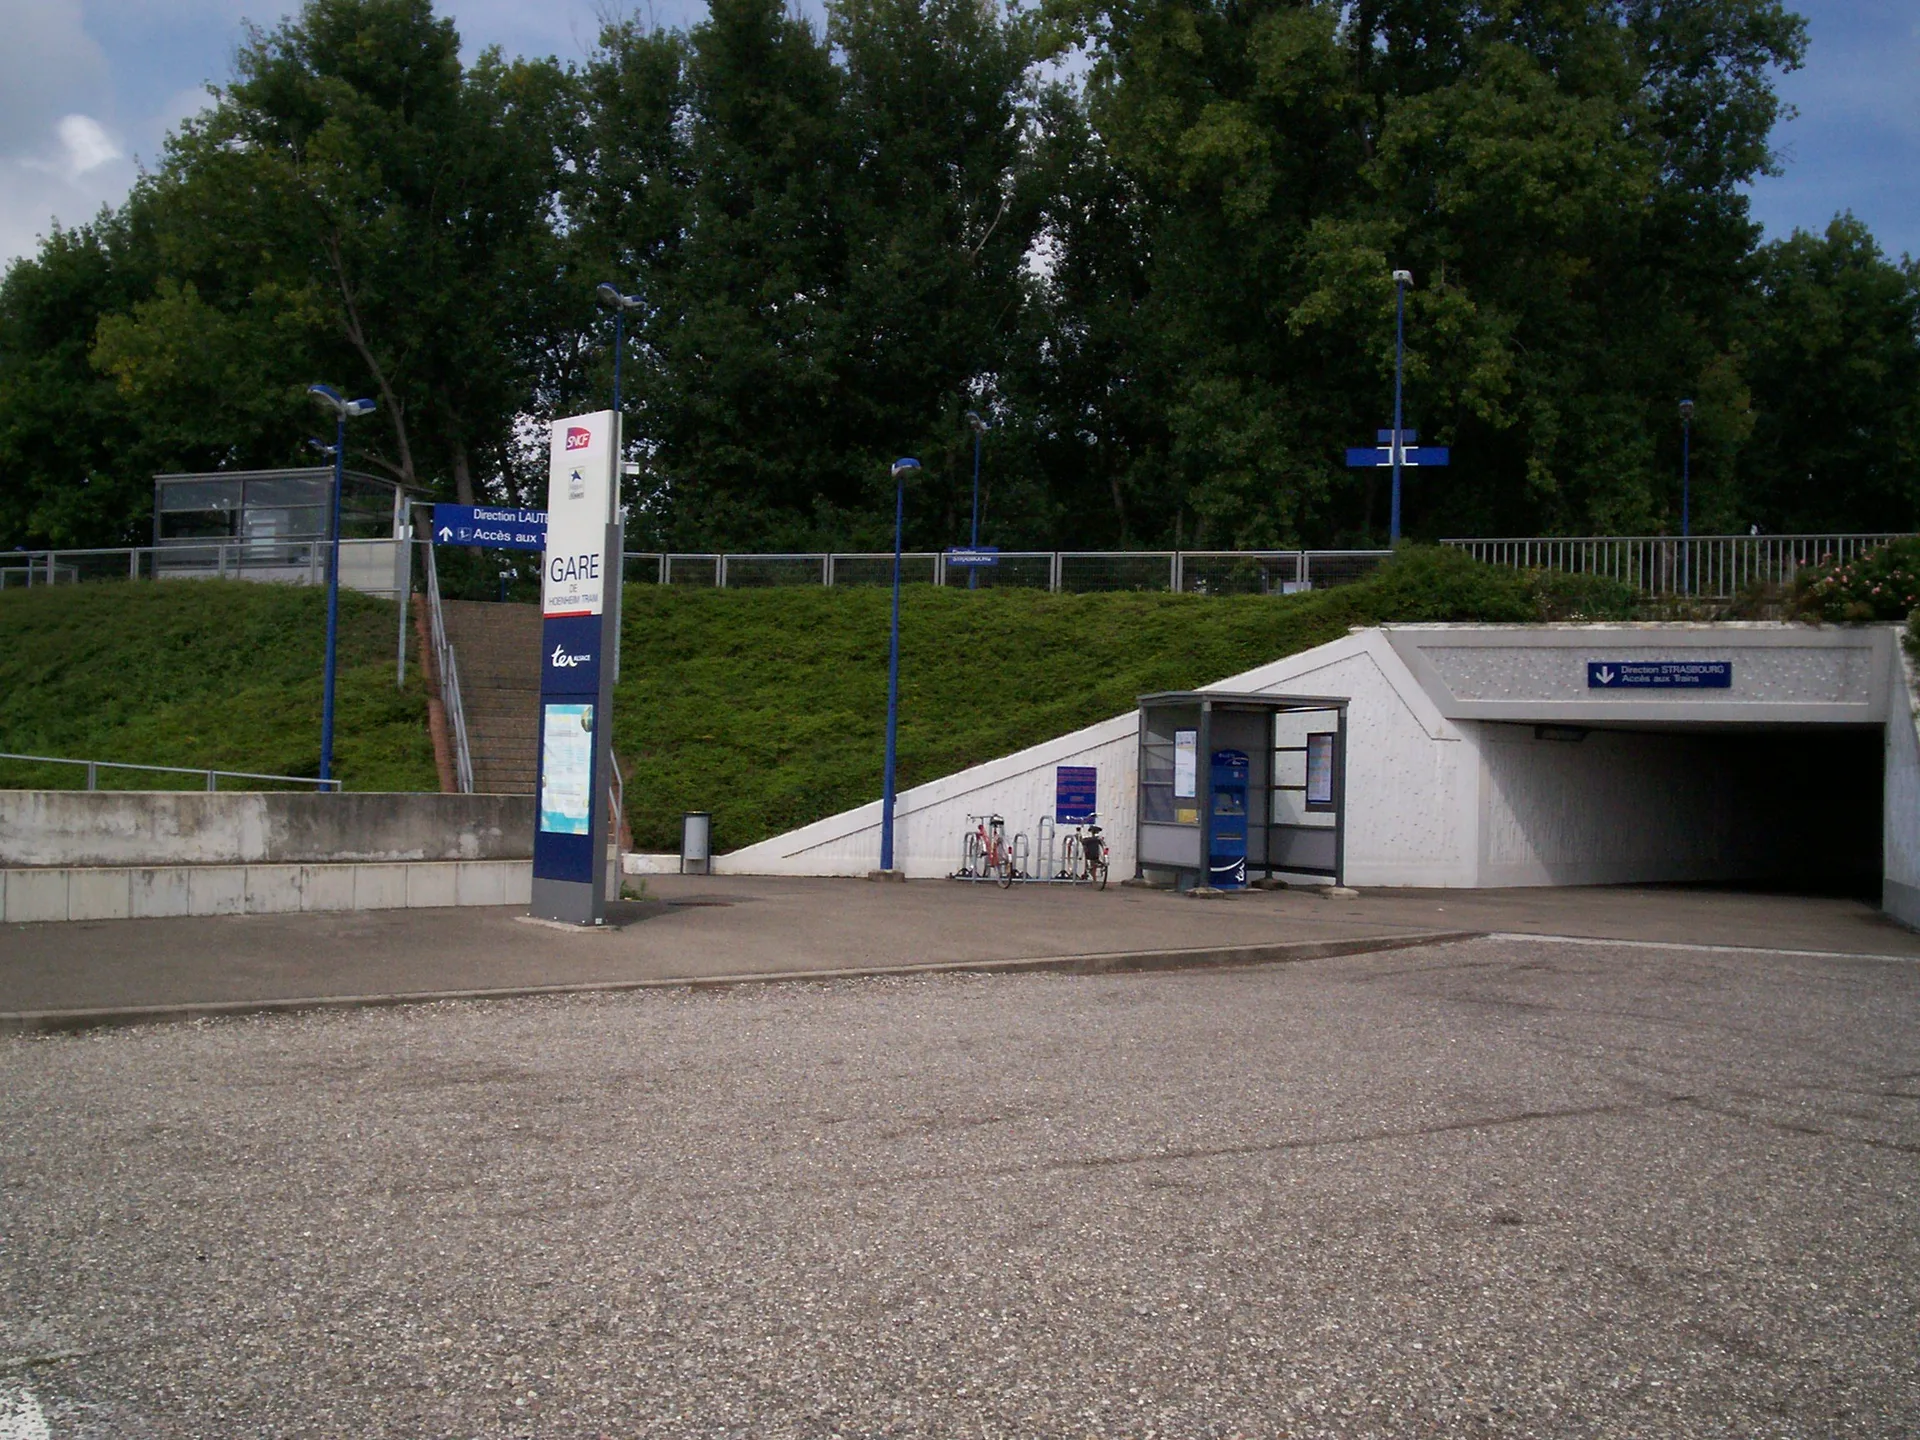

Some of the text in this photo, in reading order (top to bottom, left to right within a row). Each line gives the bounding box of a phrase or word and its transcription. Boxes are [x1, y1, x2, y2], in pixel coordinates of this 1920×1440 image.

[567, 433, 590, 448] SNCF
[473, 508, 516, 522] Direction
[473, 528, 511, 542] Accès
[515, 533, 537, 543] aux
[550, 553, 599, 583] GARE
[569, 583, 578, 593] DE
[551, 644, 578, 667] ter
[1621, 665, 1725, 674] Direction STRASBOURG
[1622, 674, 1650, 682] Accès
[1673, 674, 1699, 682] Trains
